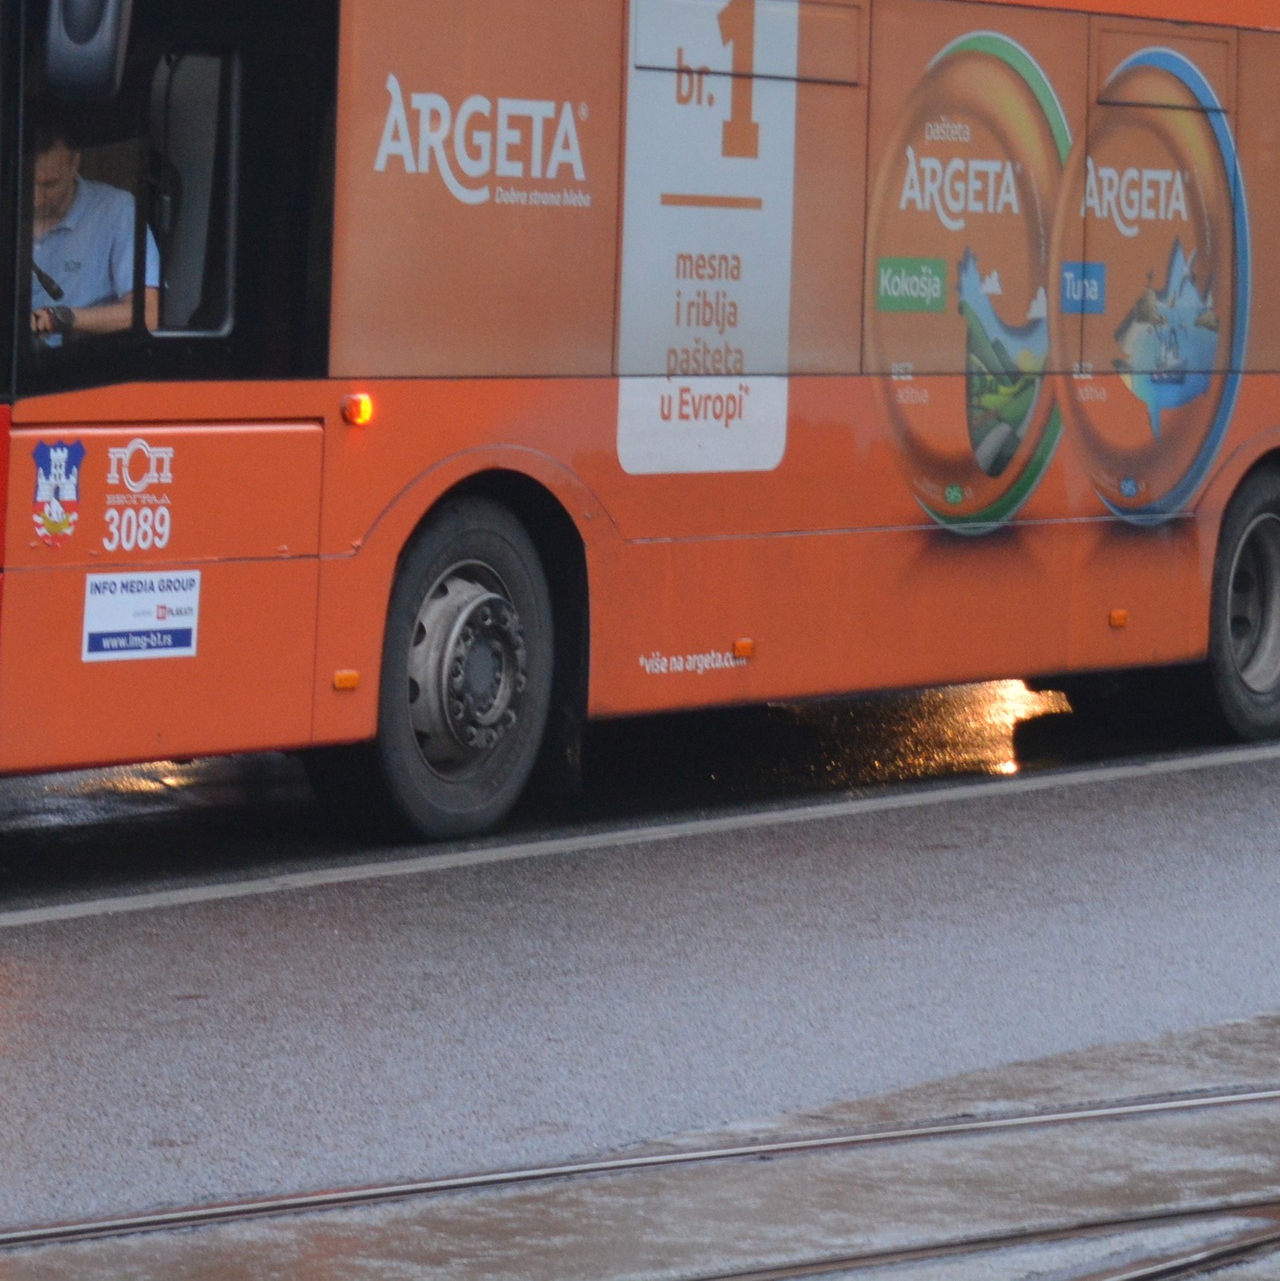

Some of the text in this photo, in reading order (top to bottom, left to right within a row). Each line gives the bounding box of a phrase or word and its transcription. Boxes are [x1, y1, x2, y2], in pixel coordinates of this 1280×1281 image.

[676, 46, 715, 107] br.
[373, 73, 587, 205] ARGETA
[900, 145, 1020, 231] ARGETA
[1080, 156, 1188, 238] ARGETA
[675, 252, 741, 281] mesna
[879, 268, 942, 304] Kokošja
[1063, 271, 1099, 301] Tuna
[675, 290, 738, 335] i riblja
[666, 337, 744, 382] pašteta
[660, 394, 672, 421] u
[102, 506, 172, 552] 3089
[90, 578, 196, 595] INFO MEDIA GROUP
